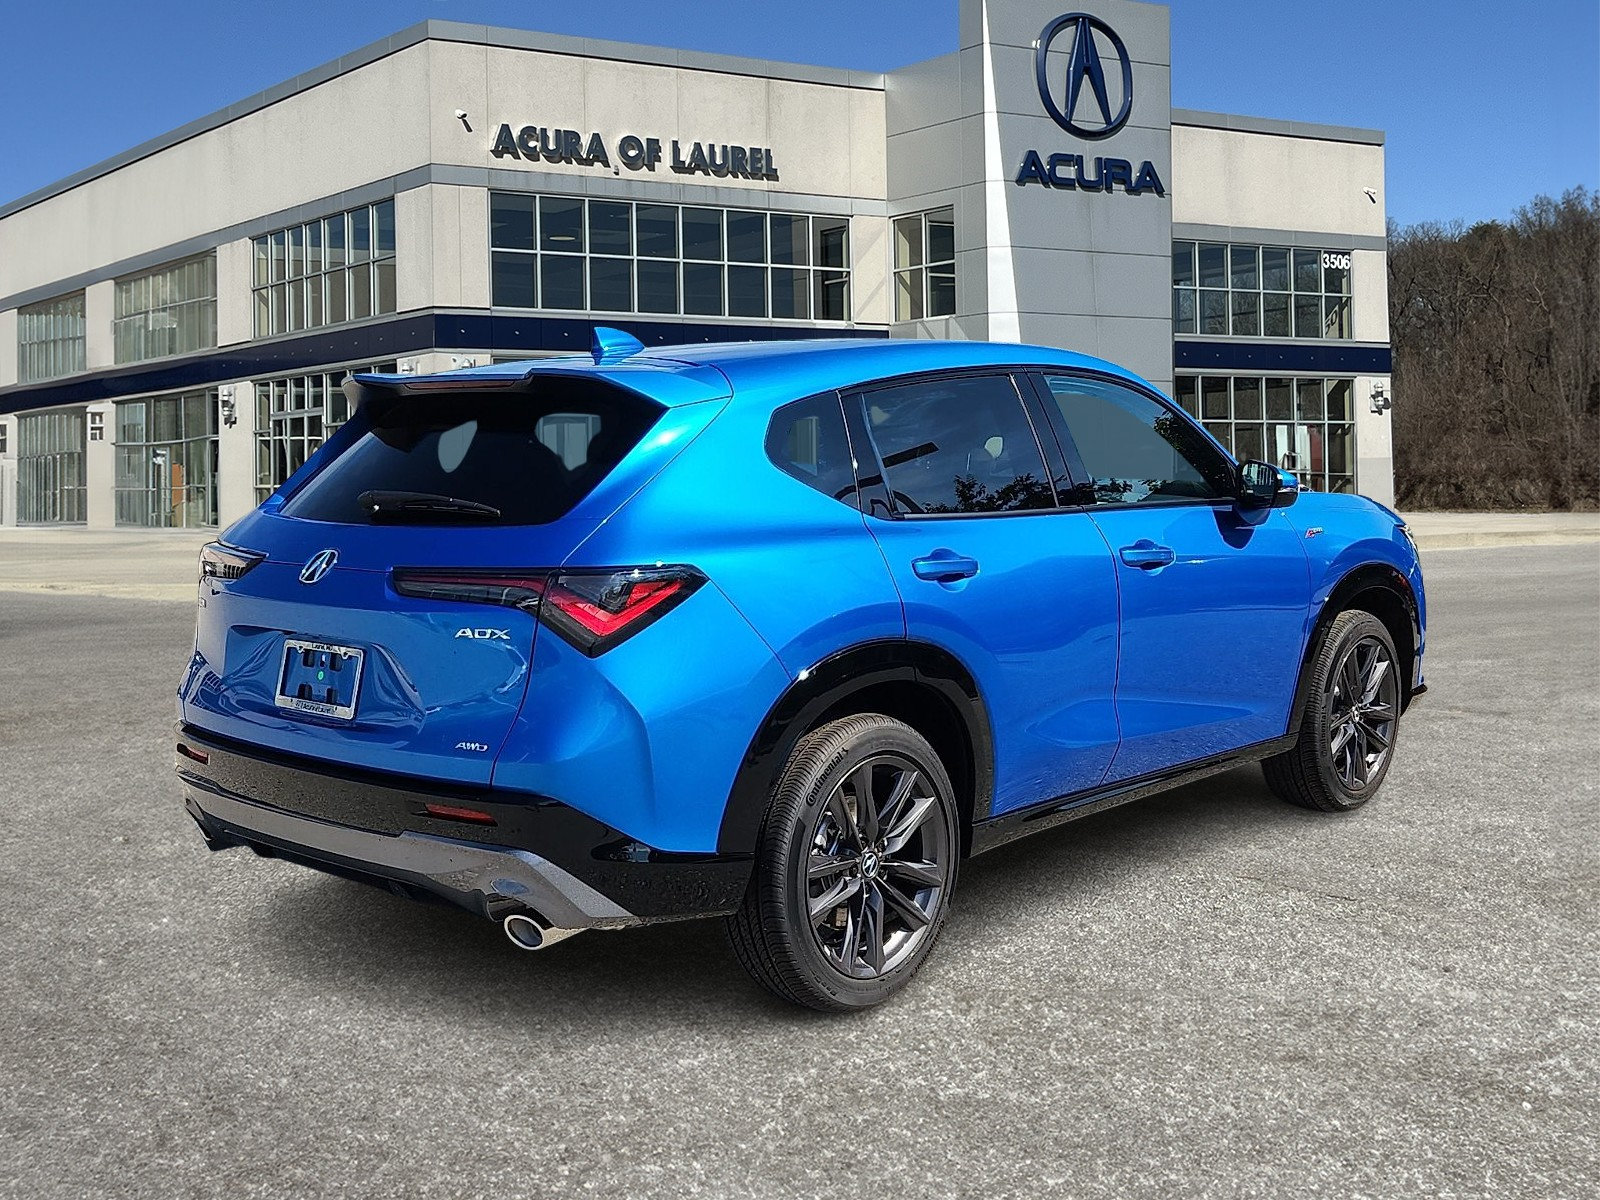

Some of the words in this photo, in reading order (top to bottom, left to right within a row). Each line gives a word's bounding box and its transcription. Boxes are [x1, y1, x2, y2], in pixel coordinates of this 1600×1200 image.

[490, 123, 610, 168] ACURA
[618, 134, 662, 171] OF
[670, 139, 779, 181] LAUREL
[1015, 149, 1166, 198] ACURA
[1322, 253, 1351, 270] 3506
[454, 627, 511, 640] ADX
[454, 741, 488, 752] AWD
[805, 751, 844, 807] Continental
